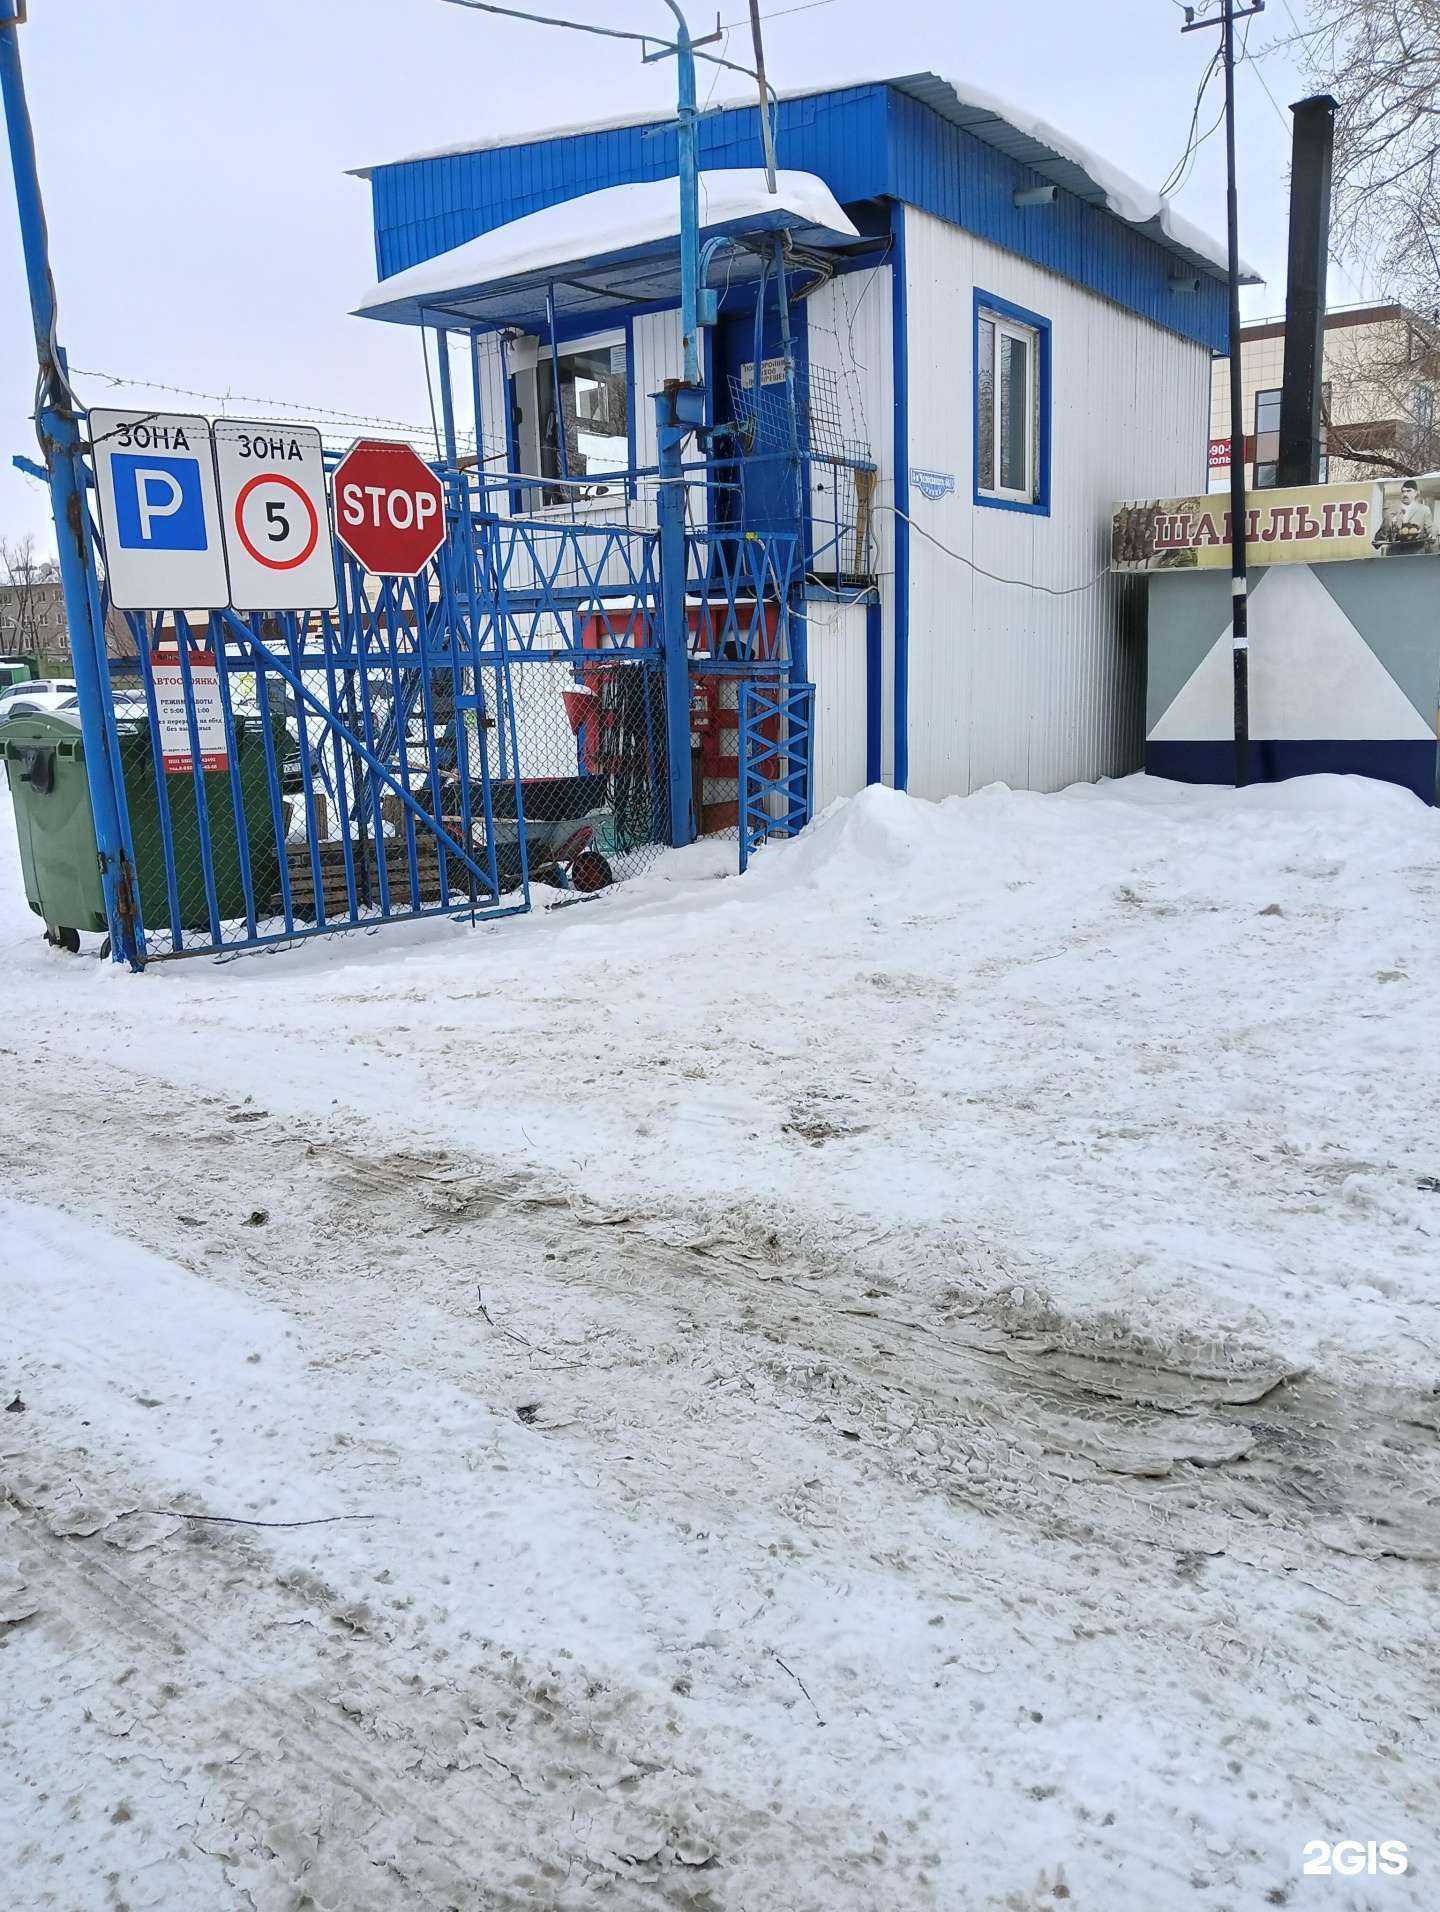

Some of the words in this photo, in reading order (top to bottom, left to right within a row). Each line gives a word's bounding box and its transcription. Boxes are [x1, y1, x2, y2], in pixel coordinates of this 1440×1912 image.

[116, 423, 191, 451] ЗОНА
[237, 434, 303, 462] ЗОНА
[134, 468, 183, 540] P
[265, 501, 290, 542] 5
[342, 483, 437, 531] STOP
[1154, 502, 1368, 548] ШАШЛЫК
[153, 677, 218, 686] ВТОСОЯНКА
